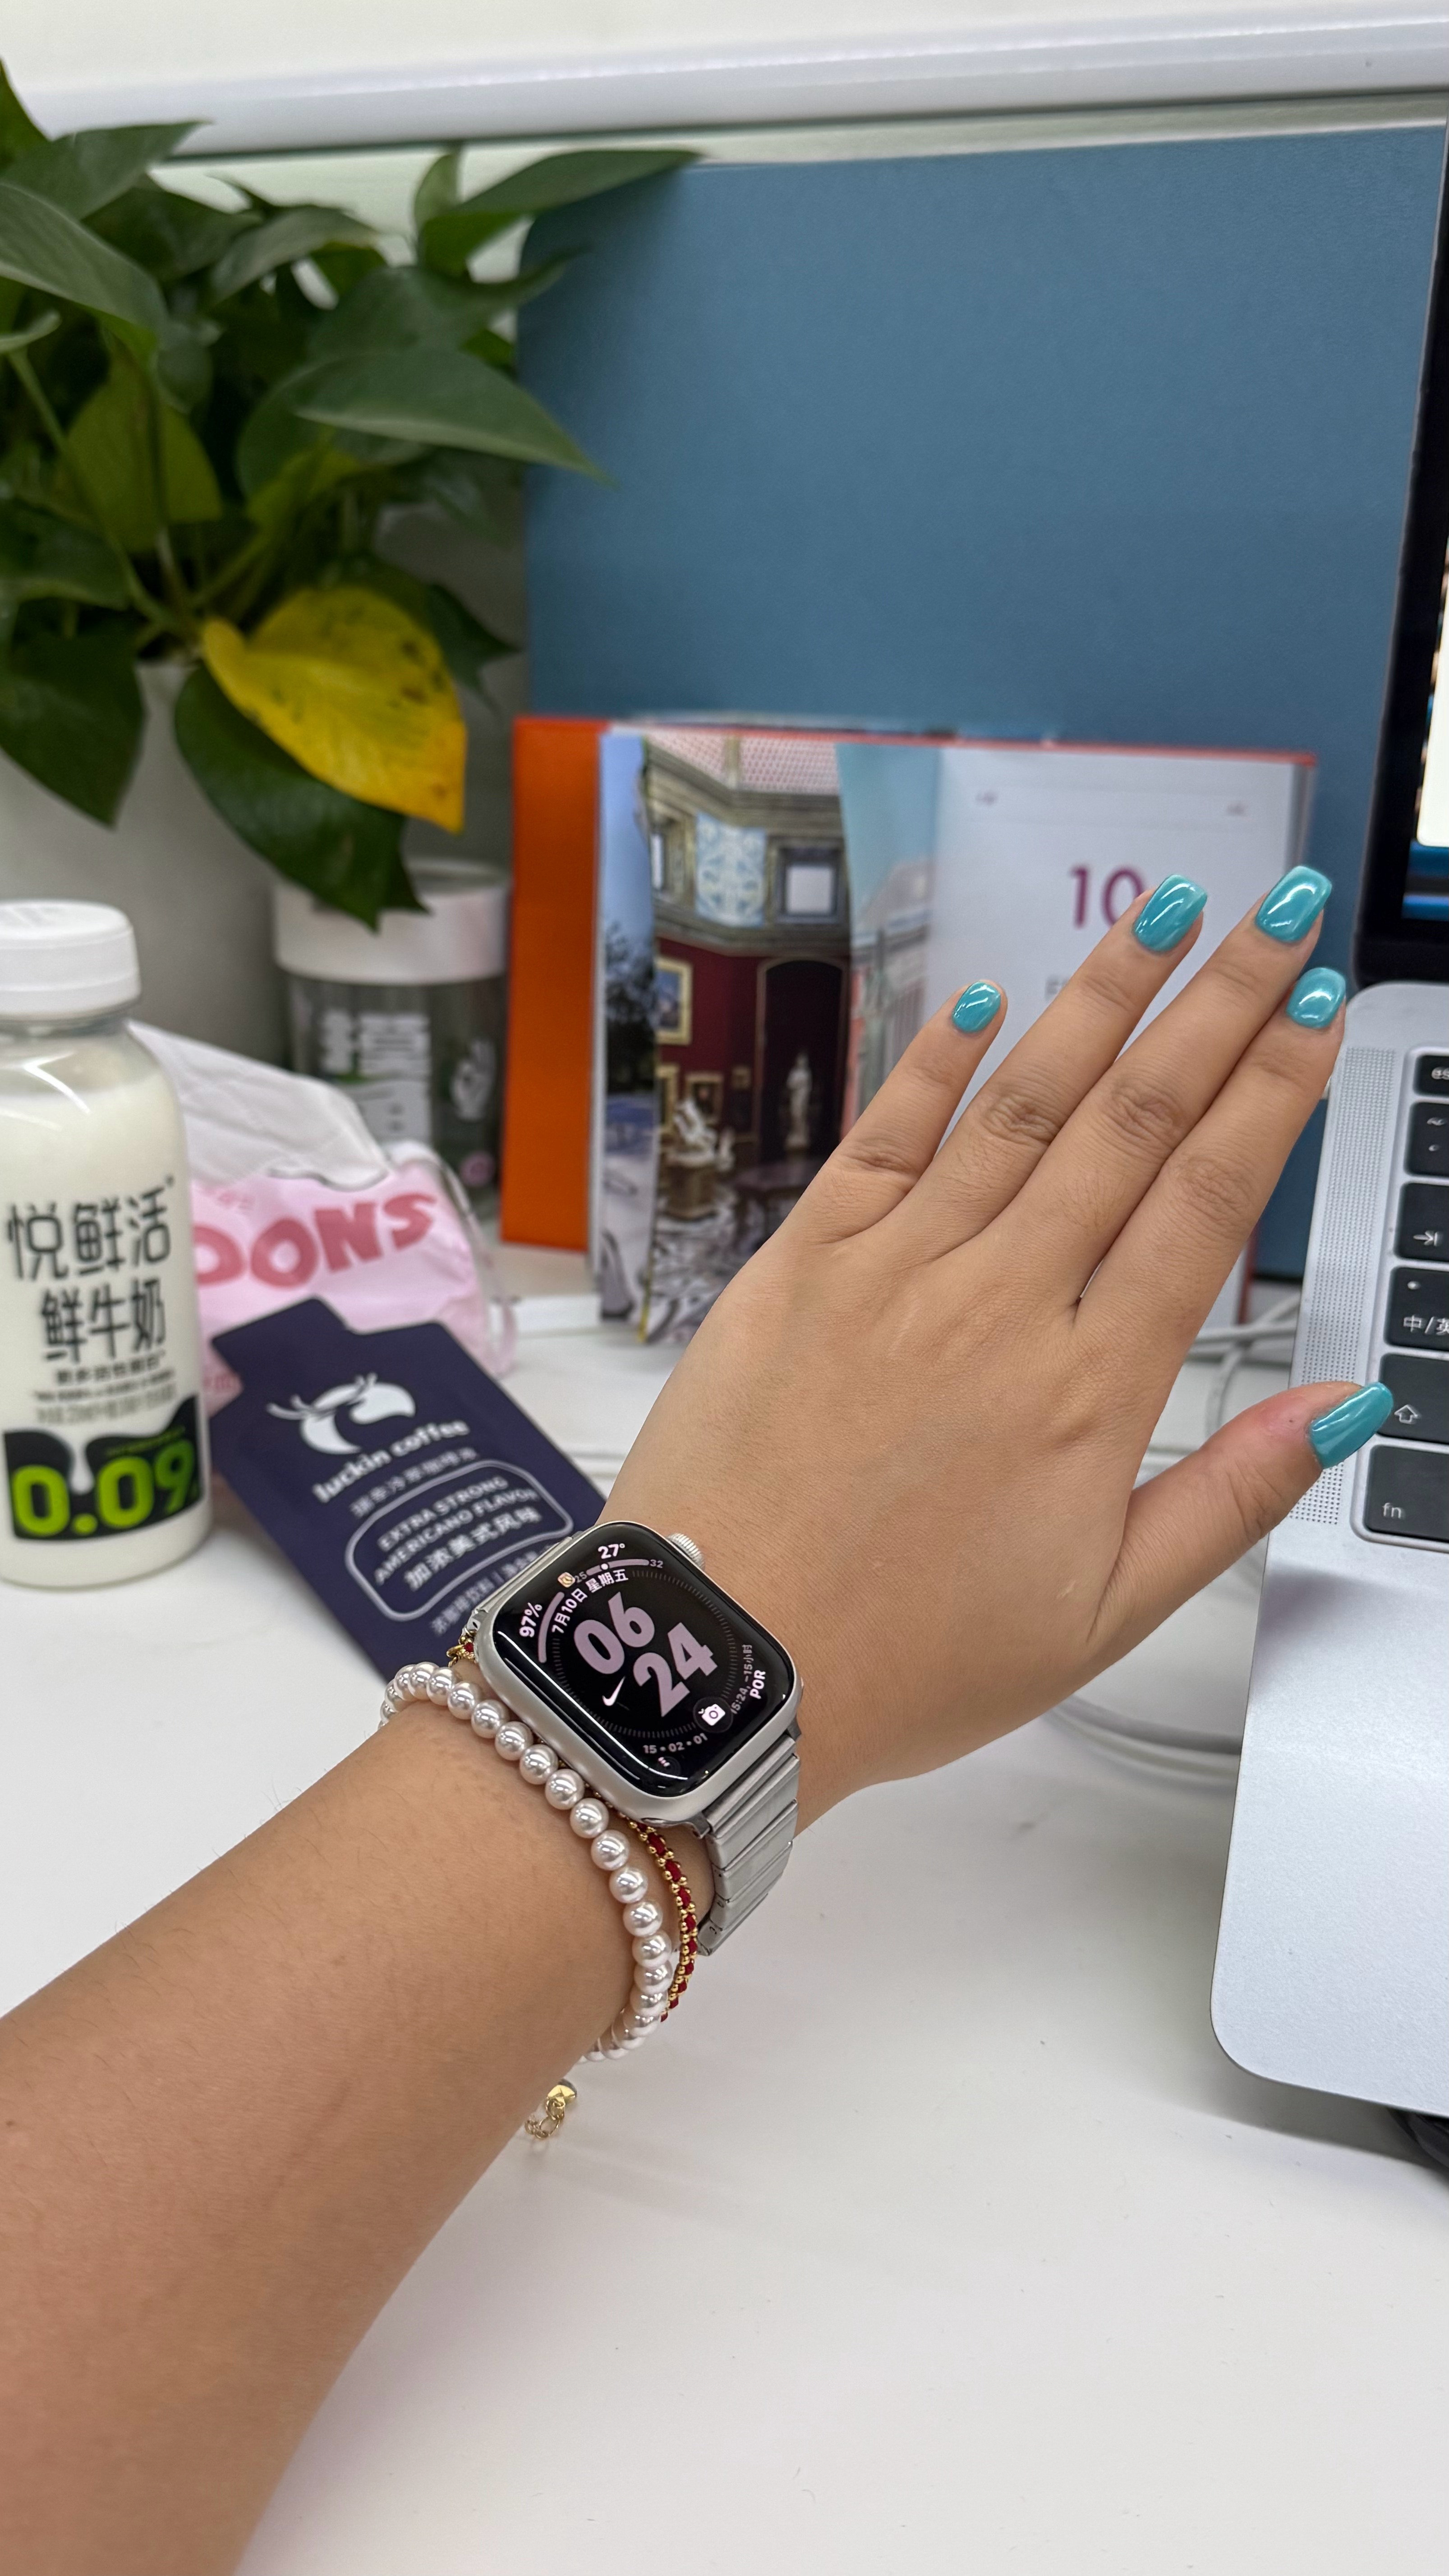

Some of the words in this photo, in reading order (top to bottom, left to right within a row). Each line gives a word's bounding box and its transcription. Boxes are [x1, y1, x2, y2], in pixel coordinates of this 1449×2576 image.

[7, 1187, 171, 1281] 悦鲜活
[41, 1277, 166, 1363] 鲜牛奶
[313, 1449, 391, 1503] luckin
[391, 1420, 470, 1457] coffee
[373, 1510, 474, 1586] AMERICANO
[377, 1508, 436, 1552] EXTRA
[432, 1476, 509, 1516] STRONG
[1382, 1502, 1402, 1519] fn
[404, 1507, 543, 1592] 加浓美式风味
[598, 1543, 626, 1559] 27°
[650, 1559, 664, 1569] 32
[519, 1602, 543, 1638] 97%
[552, 1588, 588, 1633] 7月10日
[585, 1569, 629, 1593] 星期五
[574, 1591, 655, 1674] 06
[633, 1622, 718, 1717] 24
[749, 1670, 766, 1700] POR
